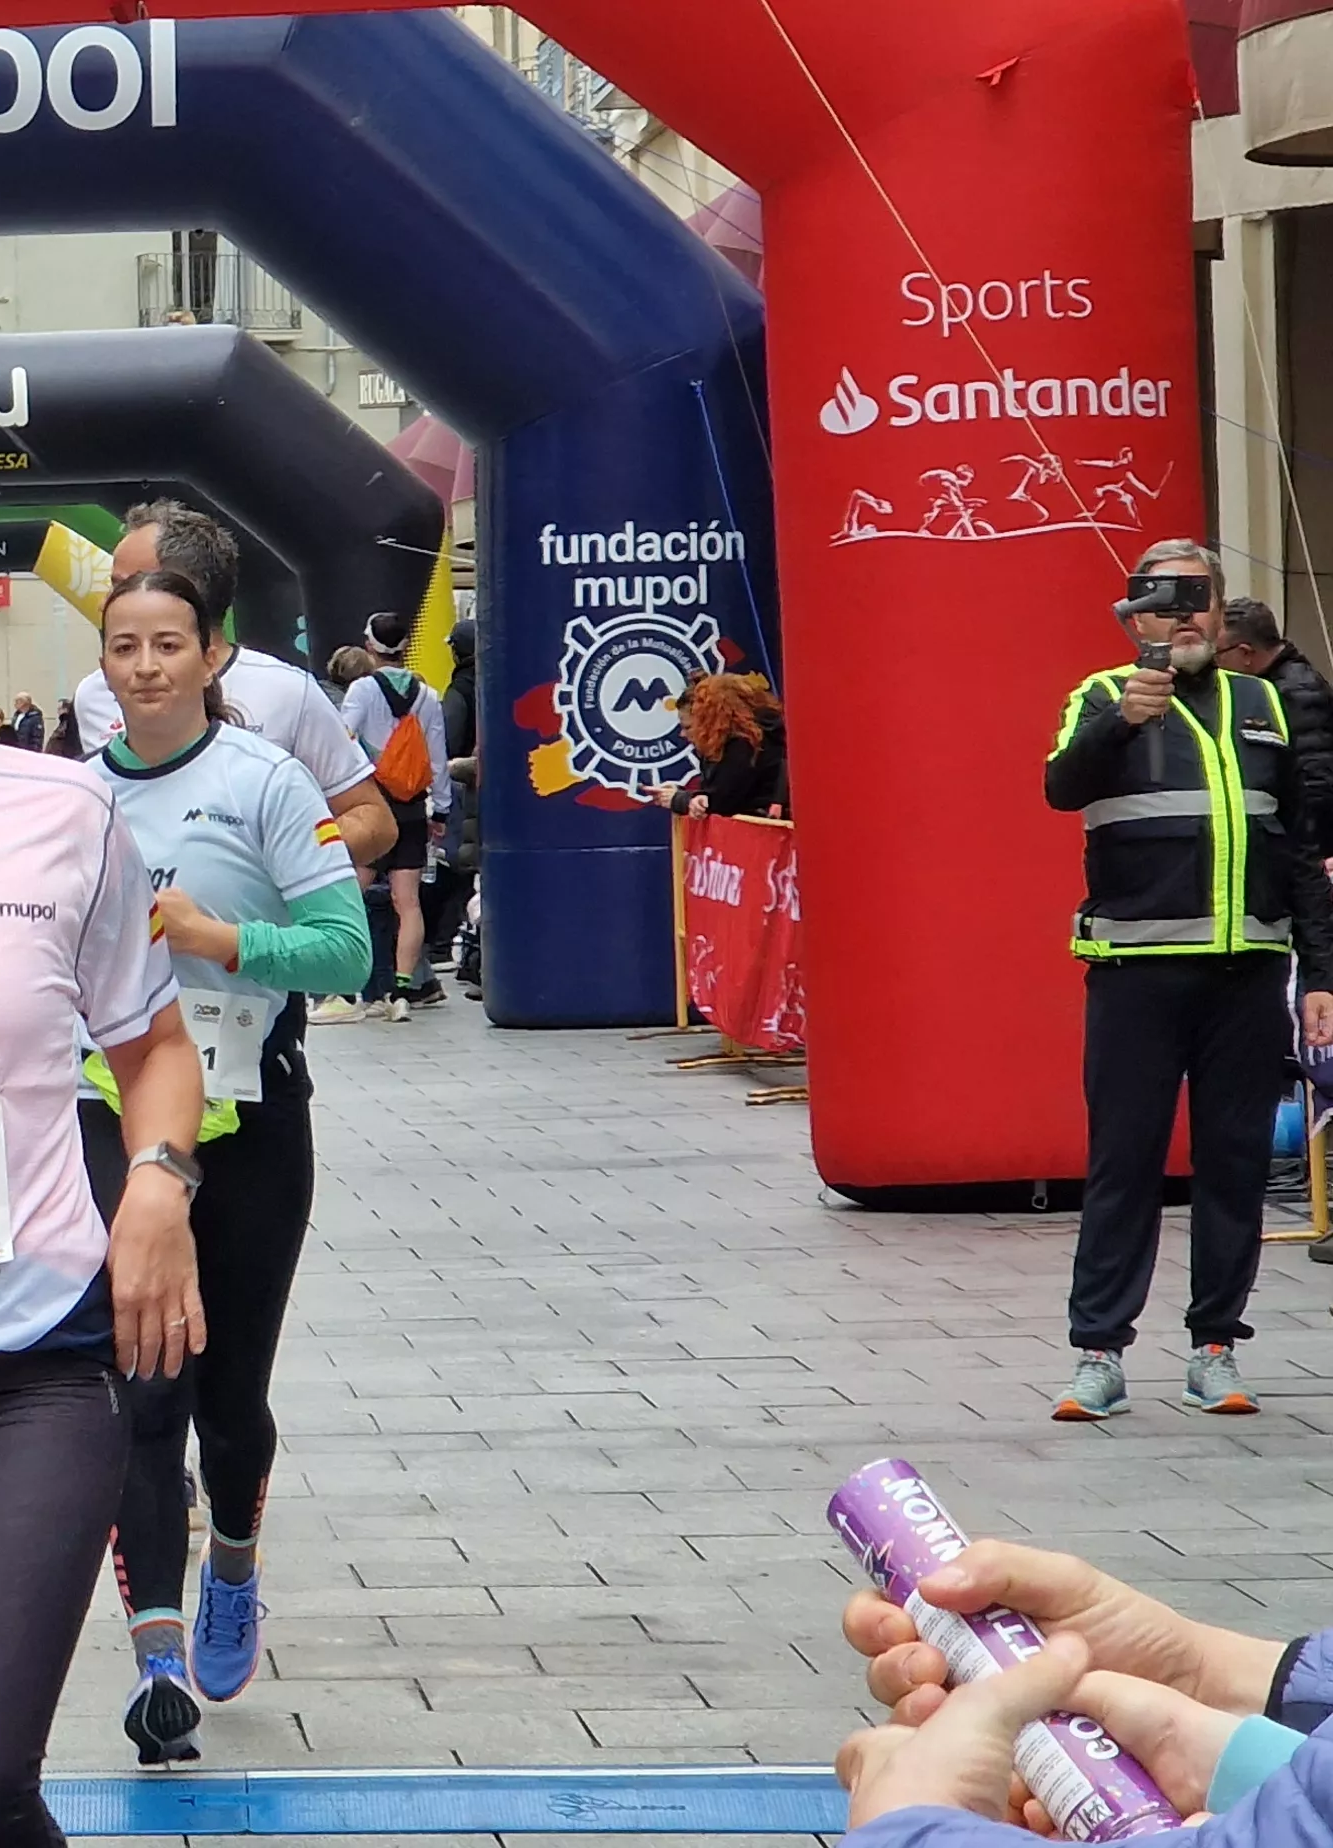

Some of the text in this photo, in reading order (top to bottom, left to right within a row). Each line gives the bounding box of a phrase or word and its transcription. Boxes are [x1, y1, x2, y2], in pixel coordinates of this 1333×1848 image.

[900, 269, 1093, 338] Sports
[888, 366, 1172, 427] Santander
[539, 519, 745, 565] fundación
[573, 564, 709, 614] mupol
[612, 739, 677, 759] POLICÍA
[0, 901, 56, 922] mupol
